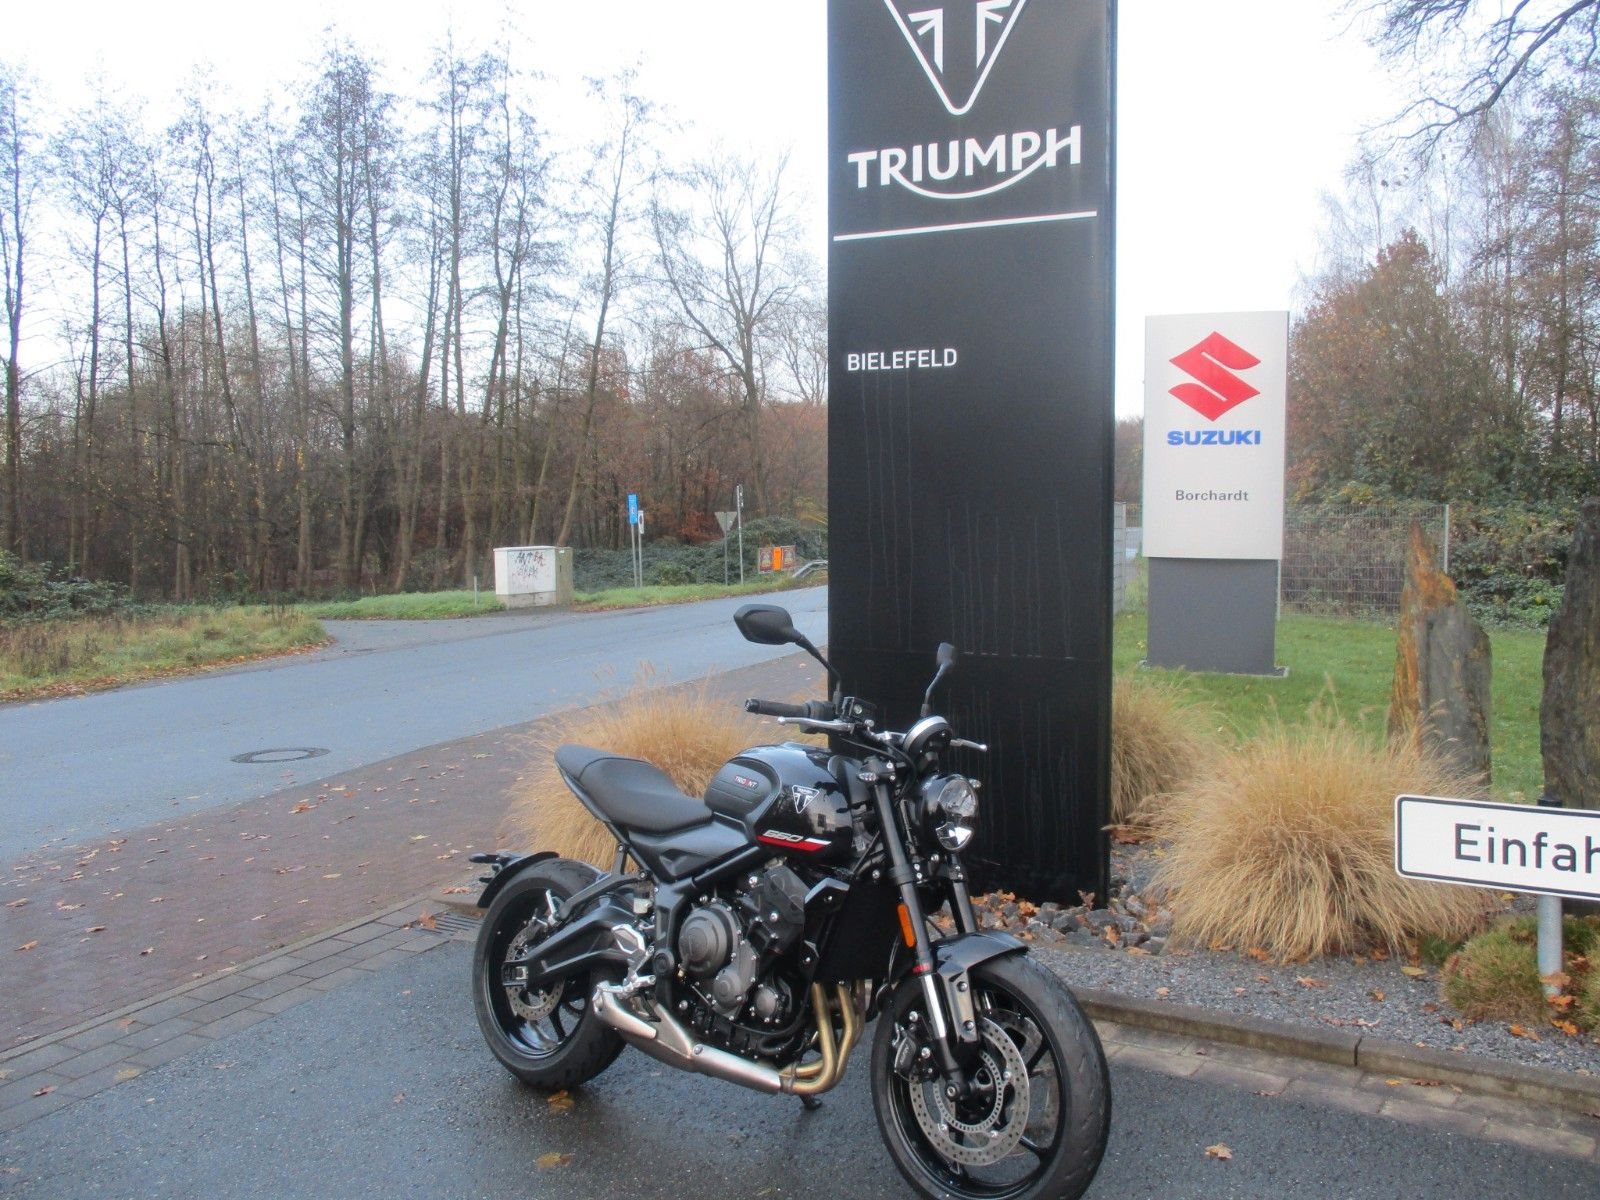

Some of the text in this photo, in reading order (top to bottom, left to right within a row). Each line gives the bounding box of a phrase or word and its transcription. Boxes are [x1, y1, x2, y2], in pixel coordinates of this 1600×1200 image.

[848, 125, 1082, 200] TRIUMPH
[847, 348, 958, 372] BIELEFELD
[1167, 429, 1261, 446] SUZUKI
[1175, 489, 1249, 502] Borchardt
